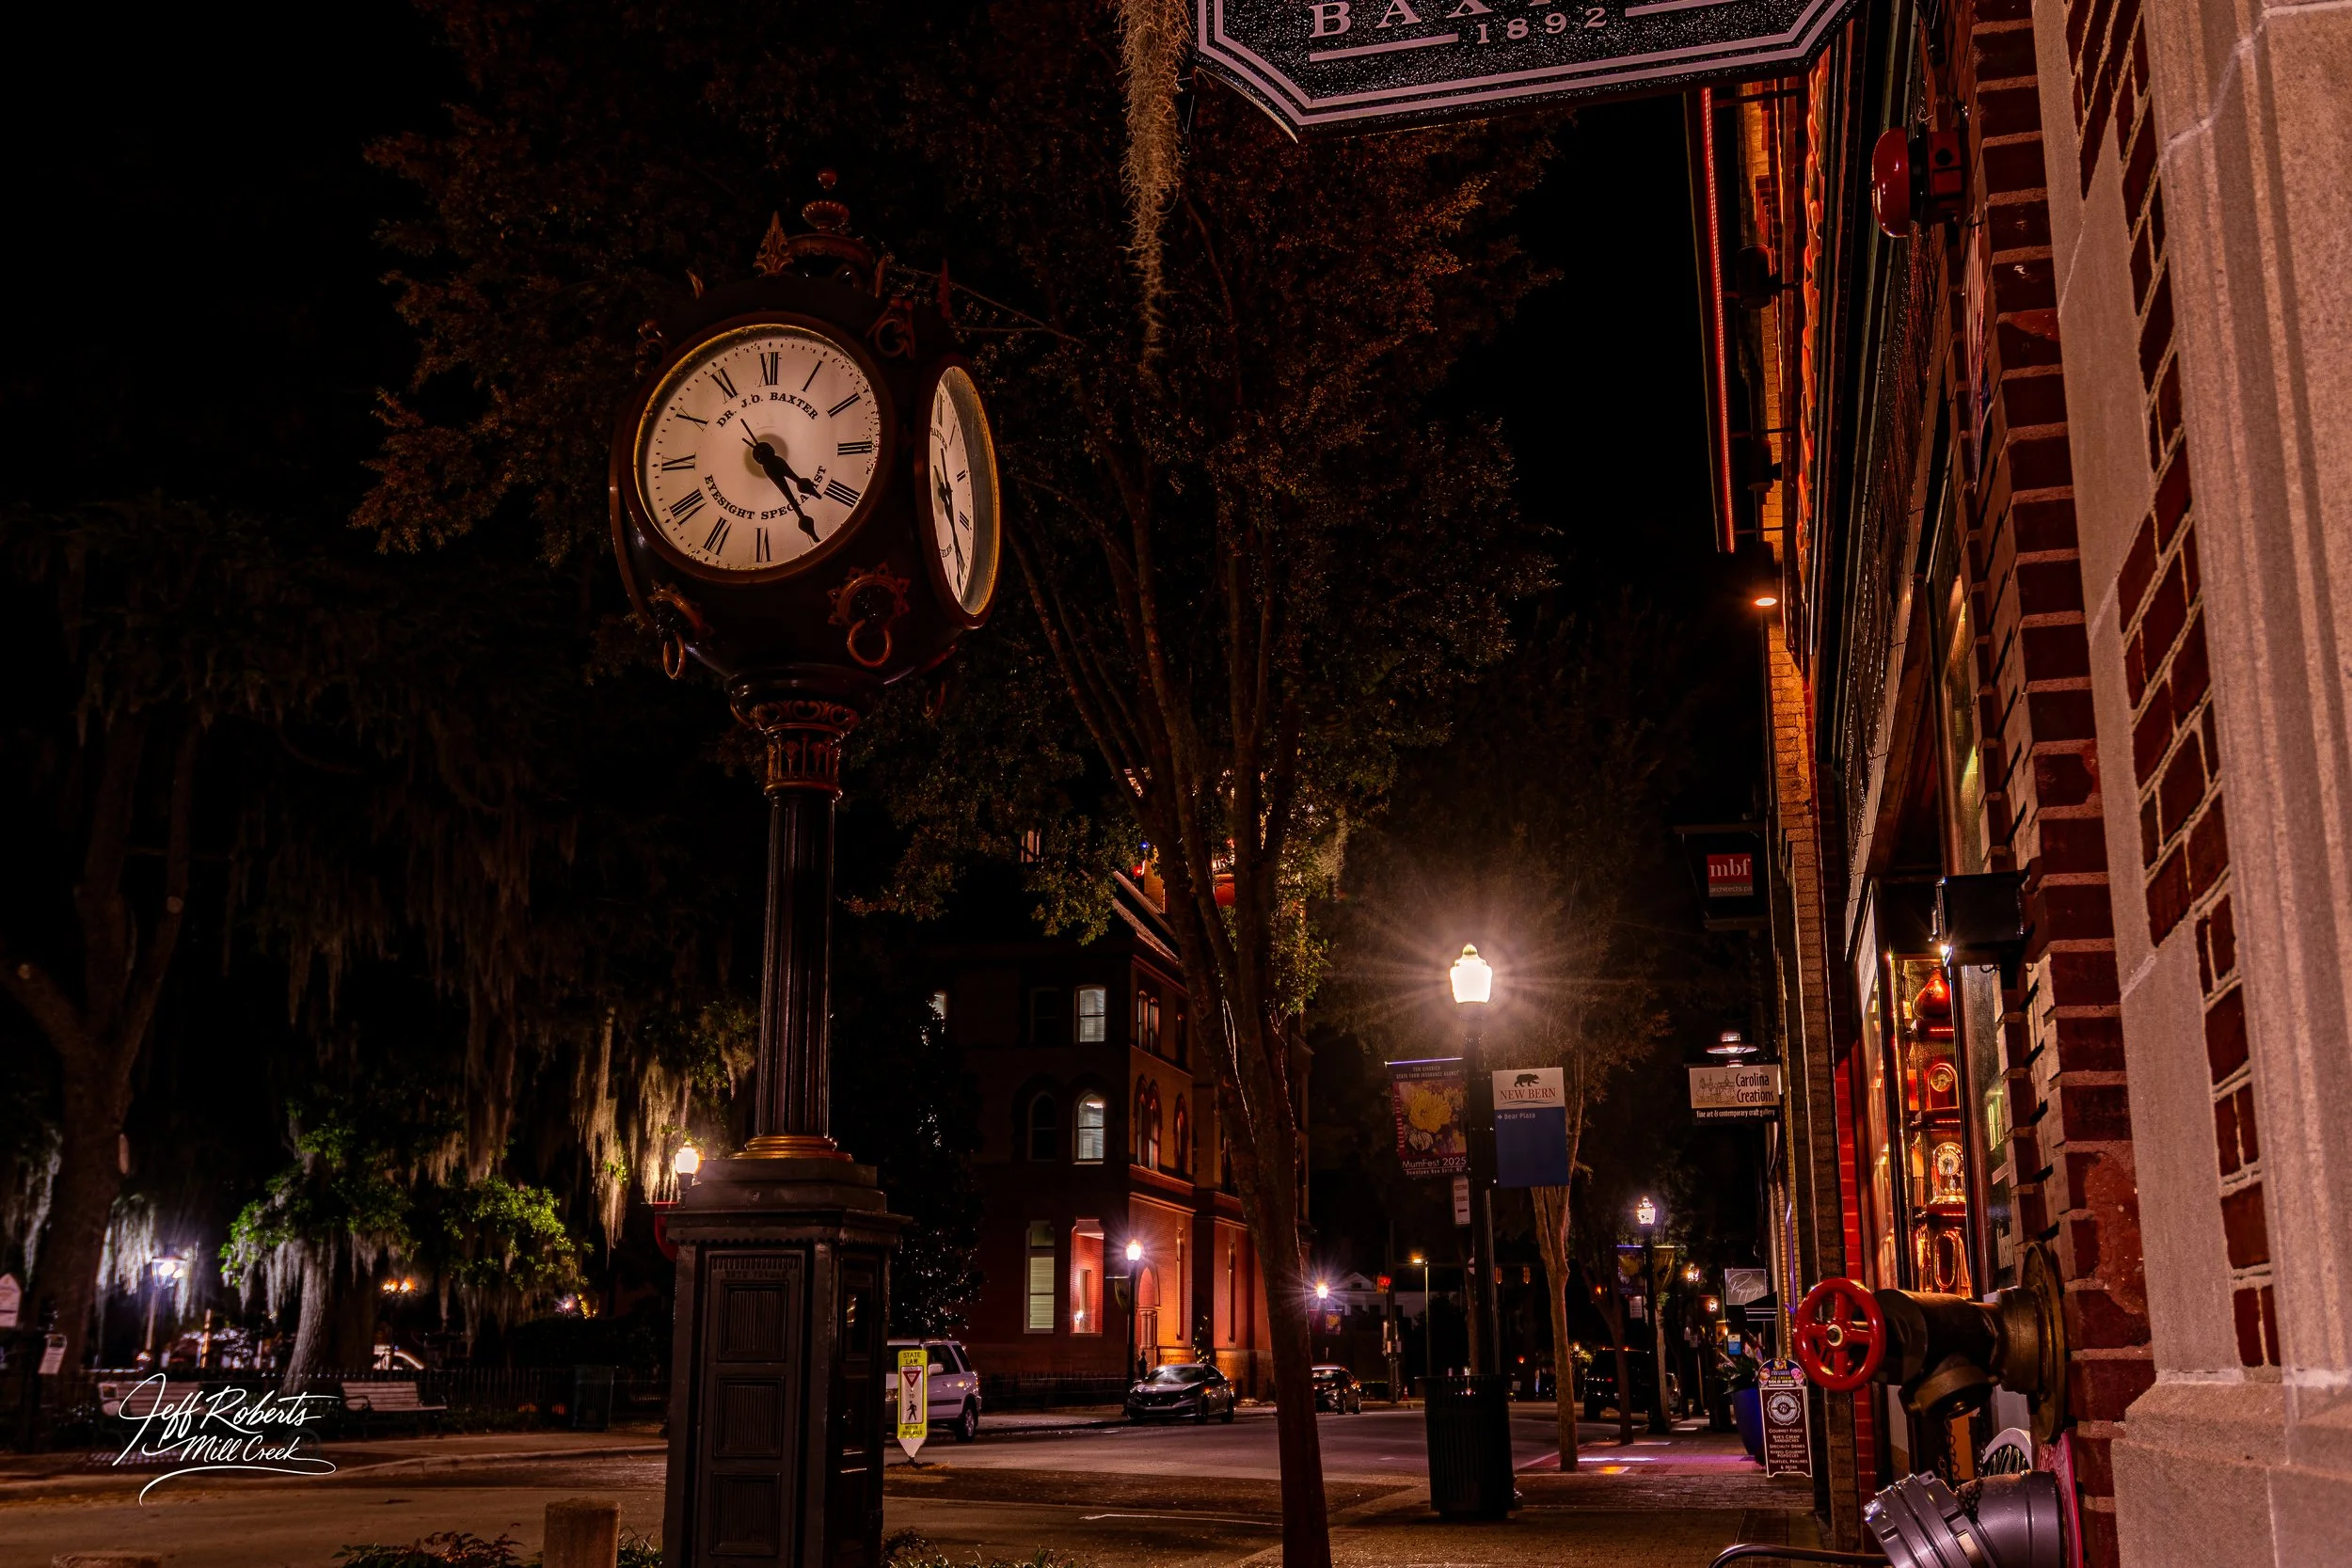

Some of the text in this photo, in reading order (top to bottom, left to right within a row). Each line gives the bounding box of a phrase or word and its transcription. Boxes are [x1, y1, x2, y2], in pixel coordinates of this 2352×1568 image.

[1477, 8, 1607, 45] 1892
[716, 410, 737, 428] DR.
[770, 391, 818, 420] BAXTER
[705, 474, 755, 519] EYESIGHT
[1708, 858, 1752, 878] mbf
[1736, 1072, 1770, 1087] Carolina
[1500, 1087, 1556, 1100] NEW BERN
[1737, 1088, 1774, 1103] Creations
[1719, 1110, 1748, 1118] contemporary
[1403, 1157, 1467, 1168] MumFest 2025
